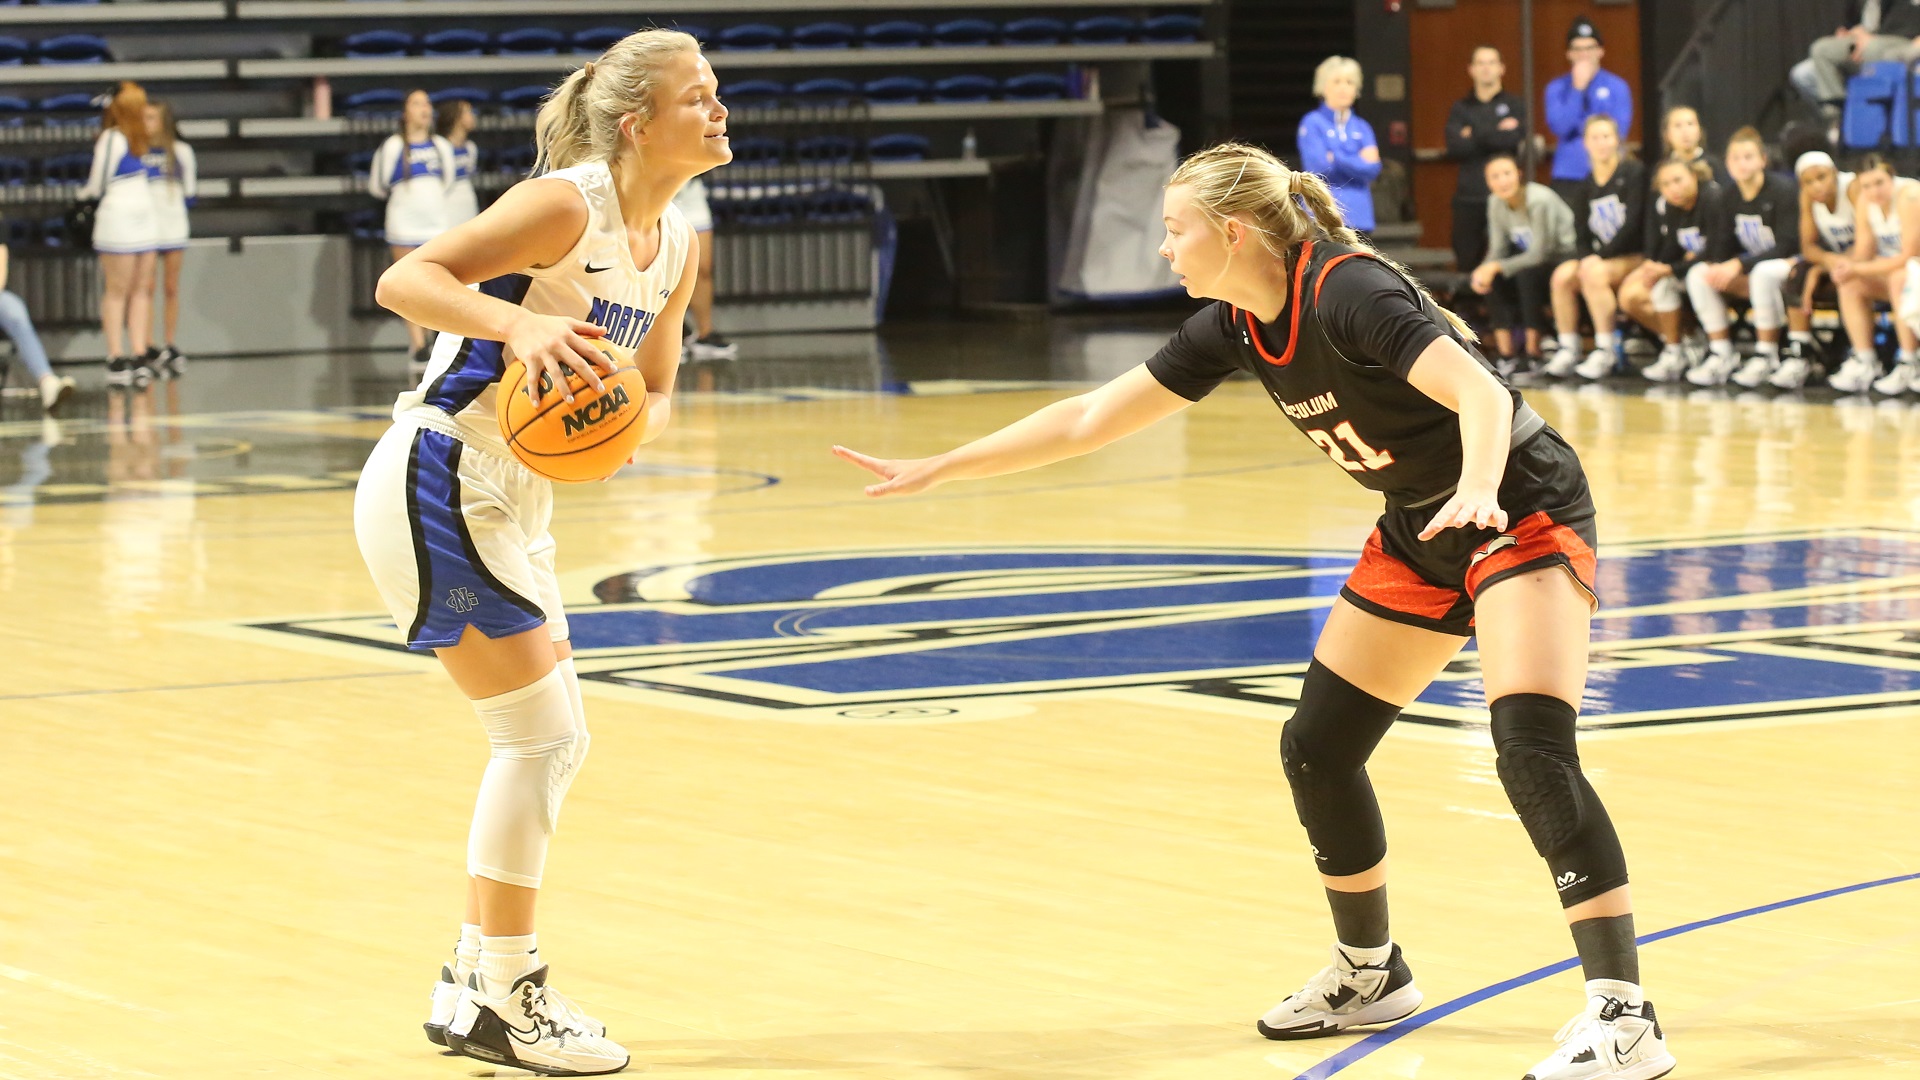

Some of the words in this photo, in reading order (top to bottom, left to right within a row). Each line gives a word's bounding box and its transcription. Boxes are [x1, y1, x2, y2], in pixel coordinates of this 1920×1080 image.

[586, 296, 655, 349] NORTH
[561, 383, 630, 437] NCAA
[1306, 420, 1395, 472] 21
